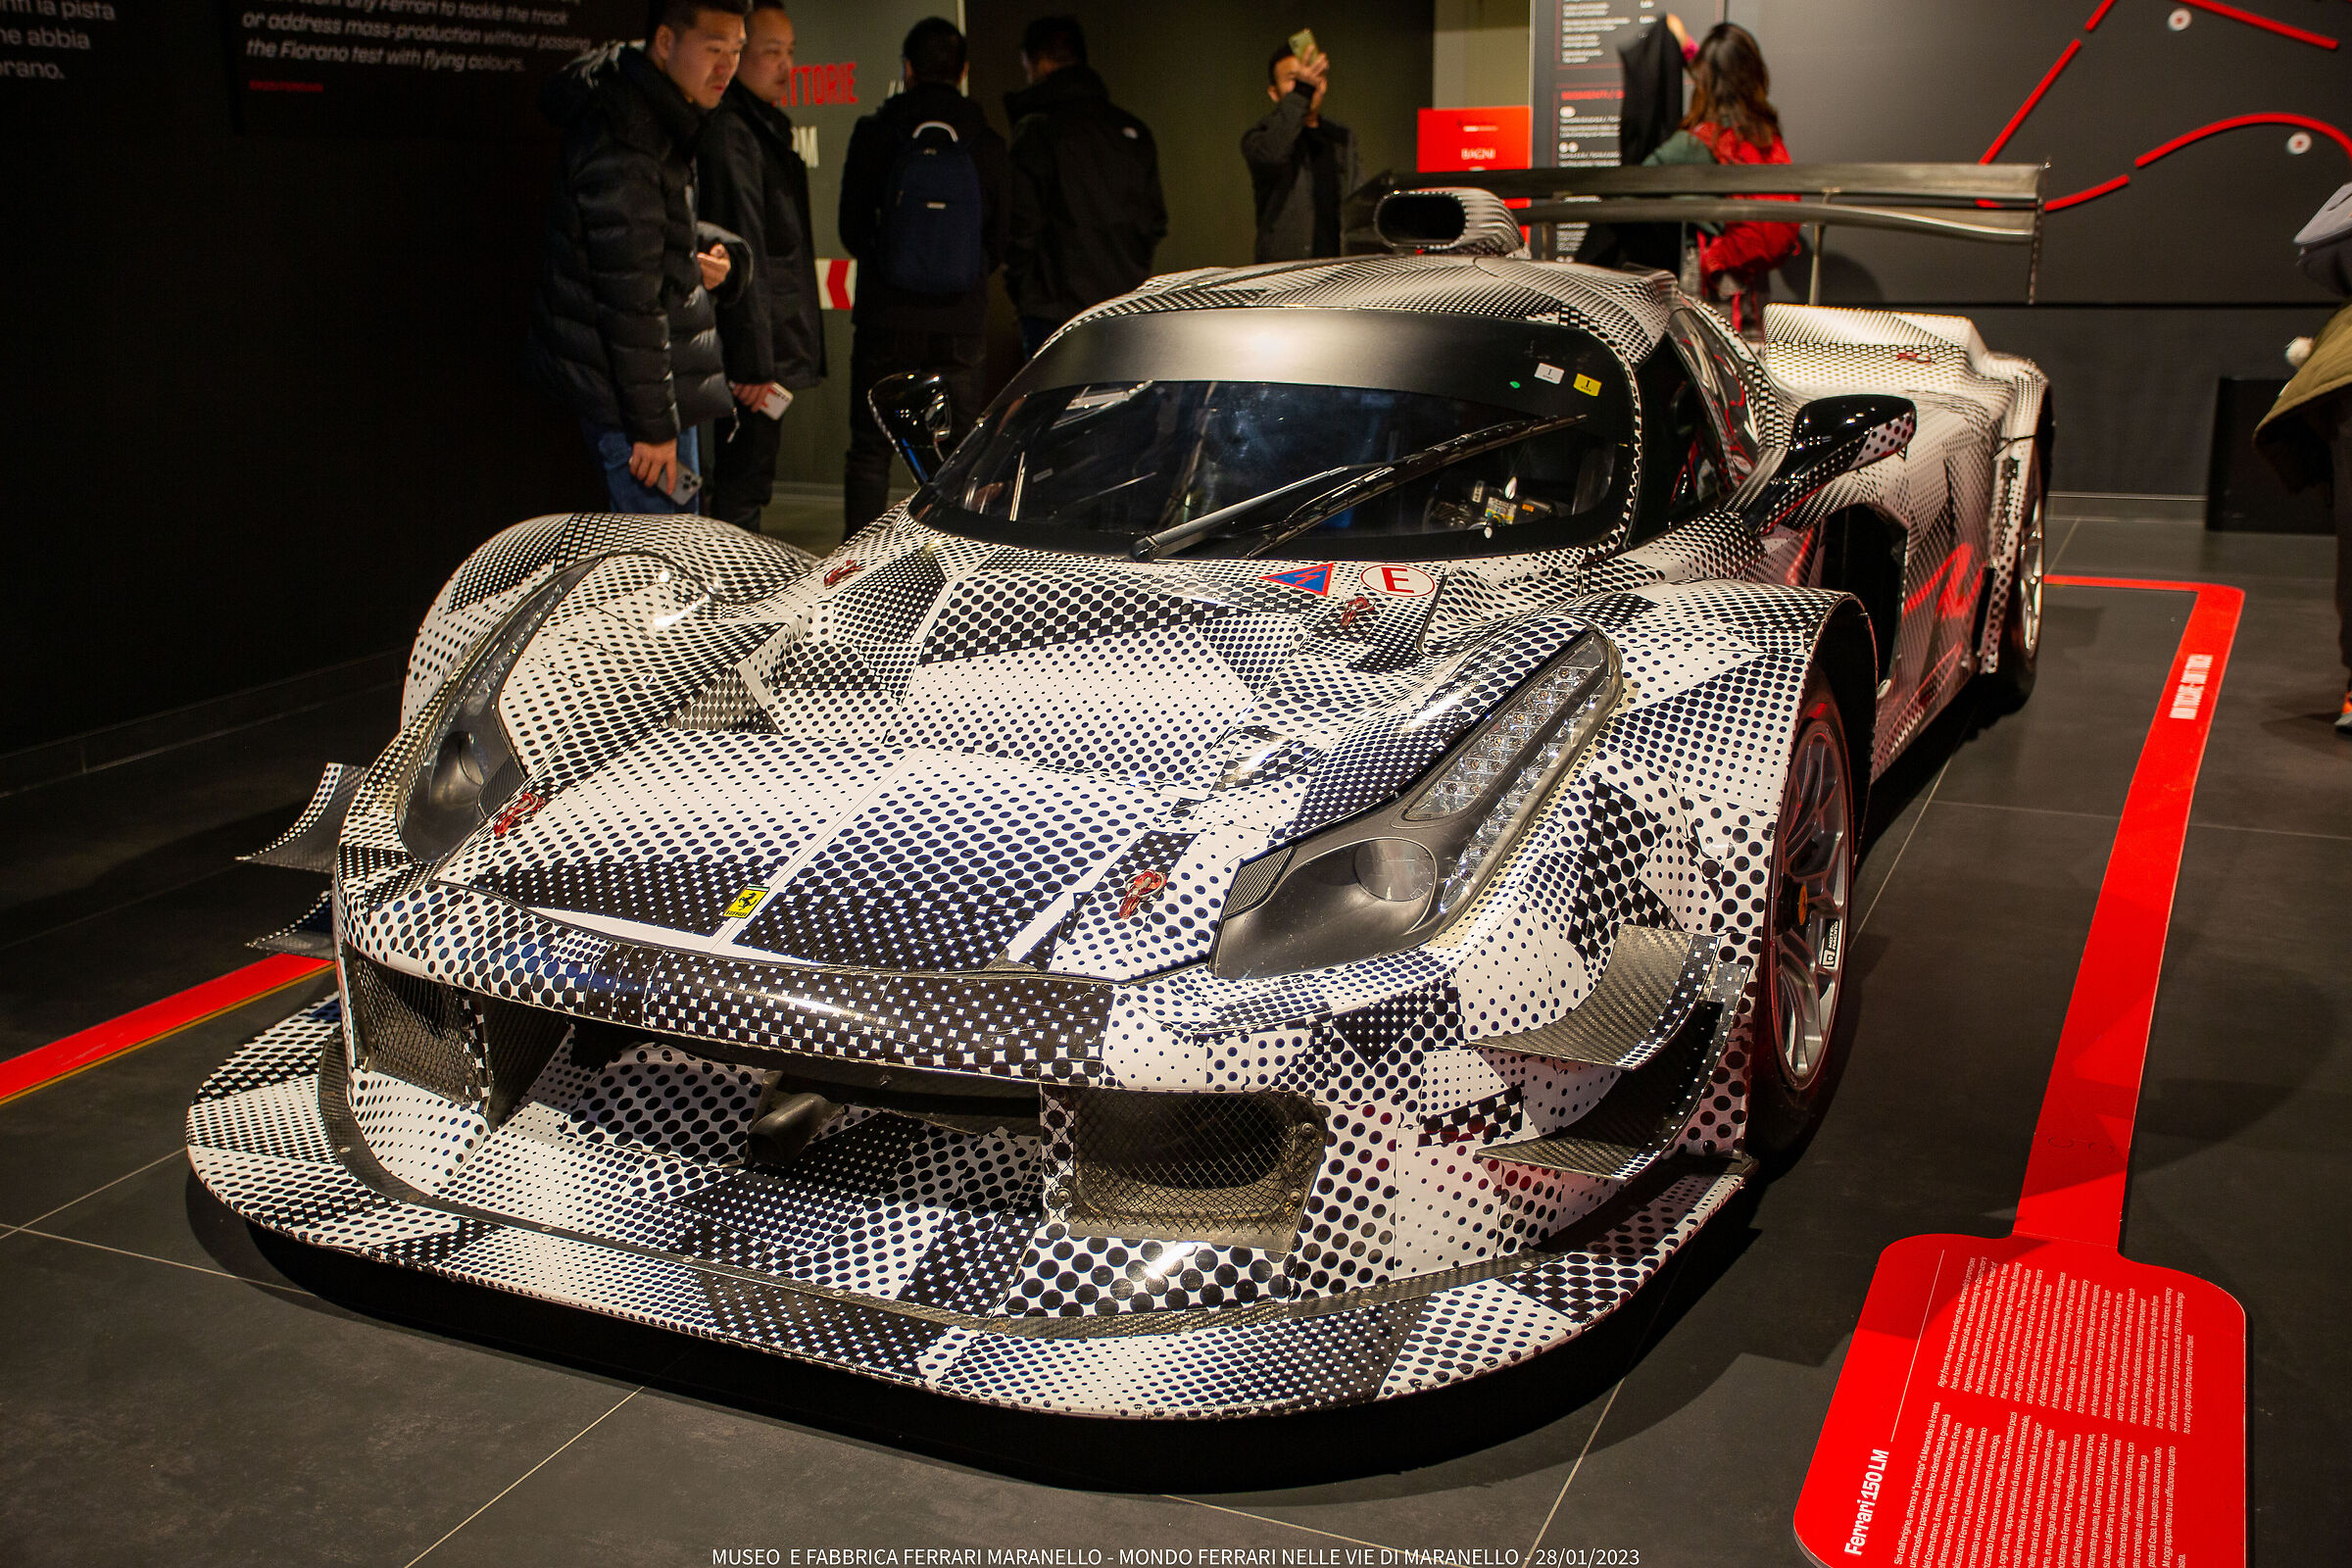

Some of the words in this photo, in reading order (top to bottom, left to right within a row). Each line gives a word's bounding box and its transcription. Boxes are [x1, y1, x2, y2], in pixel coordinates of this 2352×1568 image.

[60, 1, 117, 21] pista
[241, 11, 266, 28] or
[268, 12, 342, 35] address
[26, 24, 91, 49] abbia
[246, 38, 276, 59] the
[279, 39, 349, 64] Fiorano
[351, 43, 384, 65] test
[385, 45, 421, 66] with
[422, 47, 466, 73] flying
[0, 59, 65, 79] rano.
[1381, 566, 1415, 594] E
[1965, 1428, 1974, 1441] delle
[2005, 1426, 2014, 1445] rimasti
[1926, 1473, 1936, 1491] hanno
[1931, 1442, 1943, 1472] identificato
[1940, 1414, 1950, 1436] genialità
[1941, 1461, 1952, 1490] clamorosi
[1951, 1422, 1961, 1439] Frutto
[1962, 1441, 1971, 1453] cifra
[2002, 1445, 2011, 1459] Sono
[1869, 1449, 1888, 1470] LM
[2041, 1448, 2051, 1479] conservato
[2111, 1440, 2121, 1475] performante
[2082, 1451, 2092, 1494] numerosissime
[2097, 1466, 2104, 1475] LM
[2110, 1475, 2119, 1485] più
[1861, 1472, 1882, 1499] 150
[1894, 1553, 1903, 1564] Sin
[1906, 1495, 1917, 1518] attorno
[1921, 1429, 1934, 1454] Maranello
[1931, 1401, 1939, 1419] creata
[1954, 1475, 1964, 1496] sempre
[2016, 1519, 2027, 1548] irripetibili
[2022, 1487, 2032, 1507] vittorie
[2033, 1423, 2042, 1446] maggior
[2037, 1480, 2046, 1498] hanno
[2079, 1494, 2087, 1505] alle
[2093, 1487, 2102, 1507] Ferrari
[1949, 1502, 1958, 1514] che
[2076, 1505, 2085, 1529] Fiorano
[1845, 1500, 1874, 1554] Ferrari
[2074, 1537, 2082, 1551] Pista
[2102, 1544, 2111, 1559] base
[2072, 1552, 2081, 1567] della
[2103, 1559, 2110, 1568] su
